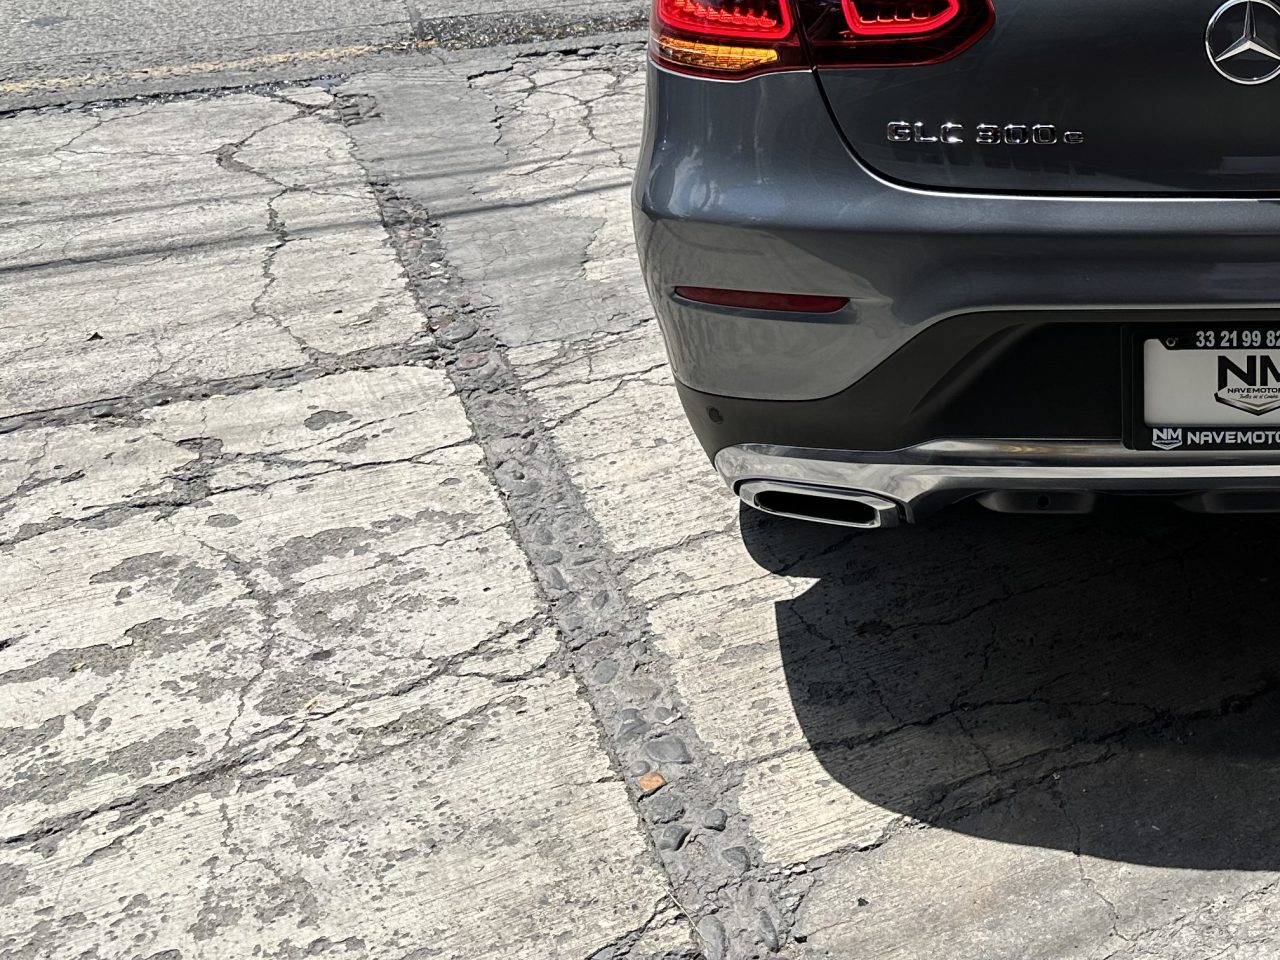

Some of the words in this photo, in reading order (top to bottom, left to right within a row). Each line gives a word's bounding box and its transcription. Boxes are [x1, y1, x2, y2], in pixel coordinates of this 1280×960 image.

[887, 121, 964, 144] GLC
[1196, 331, 1215, 347] 33
[1220, 331, 1237, 347] 21
[1242, 331, 1261, 347] 99
